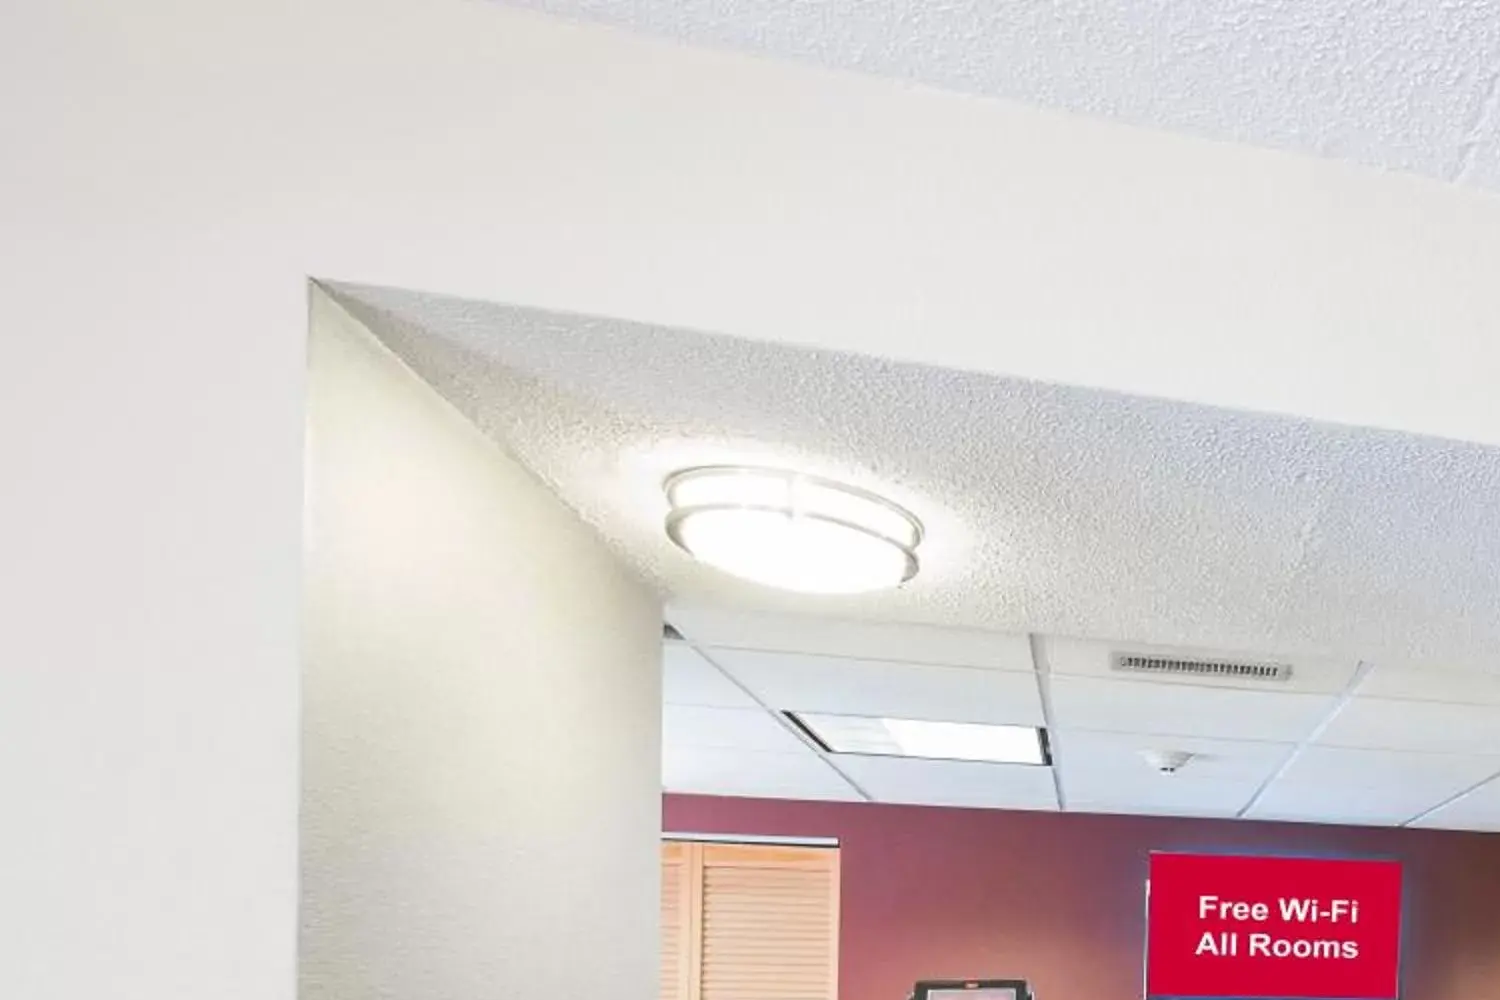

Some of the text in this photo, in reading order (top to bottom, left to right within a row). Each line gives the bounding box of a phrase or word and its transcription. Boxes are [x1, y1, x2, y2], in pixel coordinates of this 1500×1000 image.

[1199, 895, 1359, 924] Free Wi-Fi
[1195, 931, 1360, 959] All Rooms
